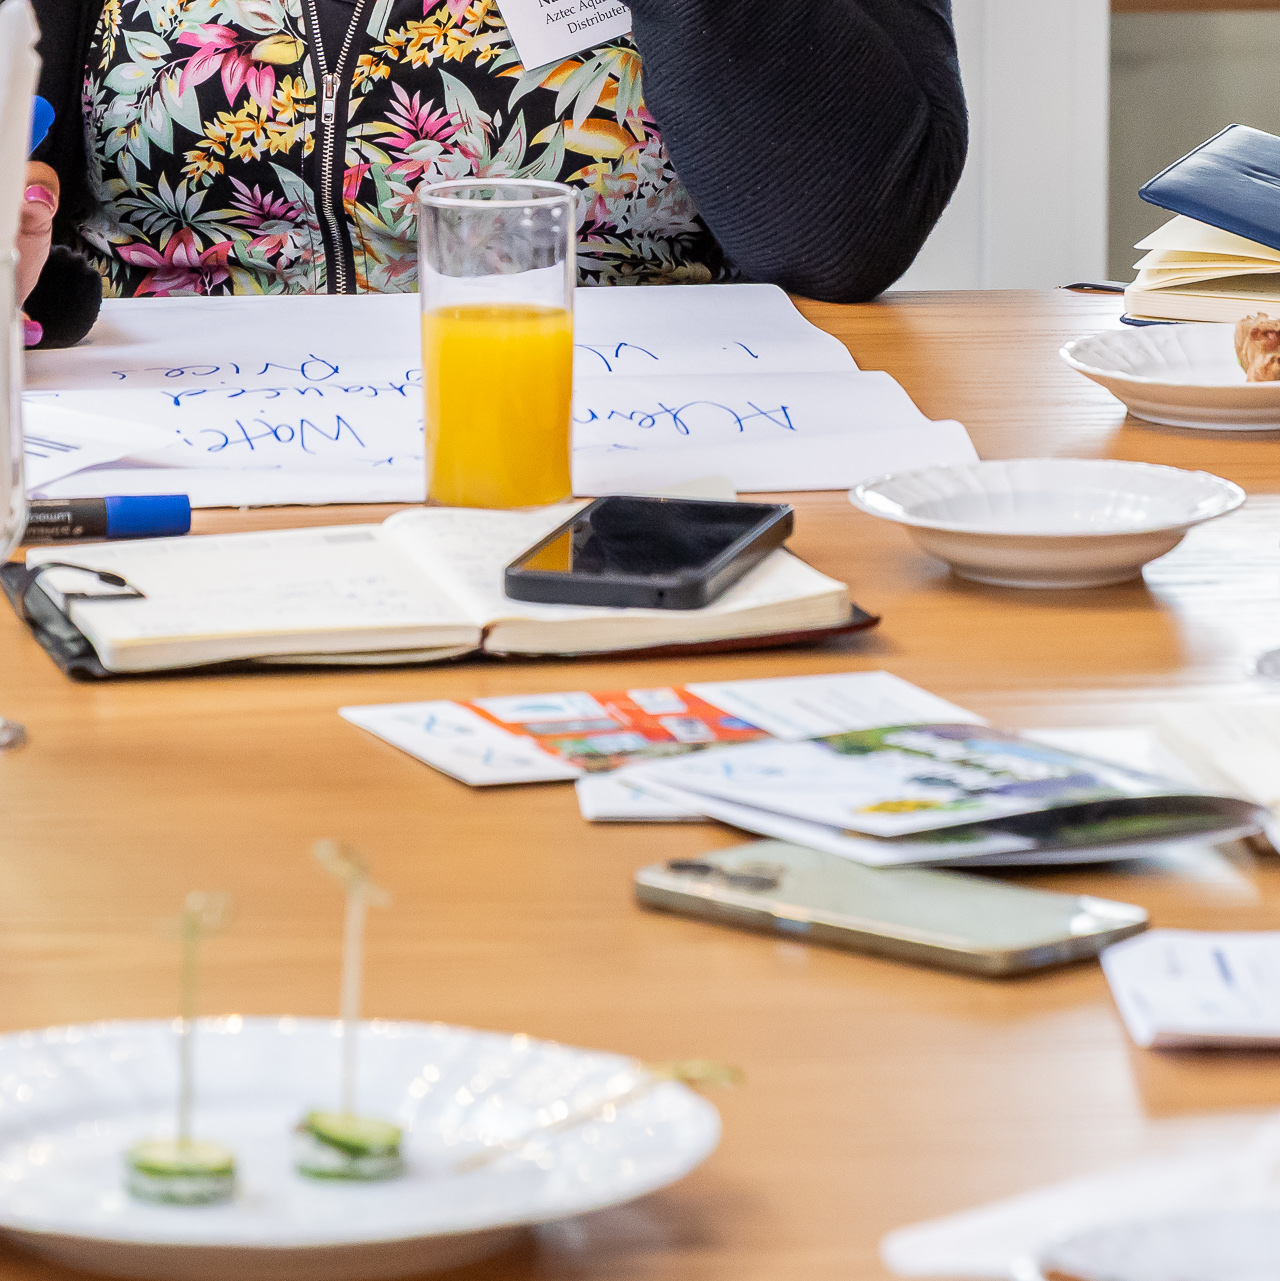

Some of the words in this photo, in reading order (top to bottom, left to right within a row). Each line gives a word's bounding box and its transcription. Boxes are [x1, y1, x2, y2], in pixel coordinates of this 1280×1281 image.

[545, 5, 576, 25] Aztec
[567, 4, 631, 34] Distributer
[573, 401, 798, 436] Altern
[27, 510, 72, 524] Lumoco
